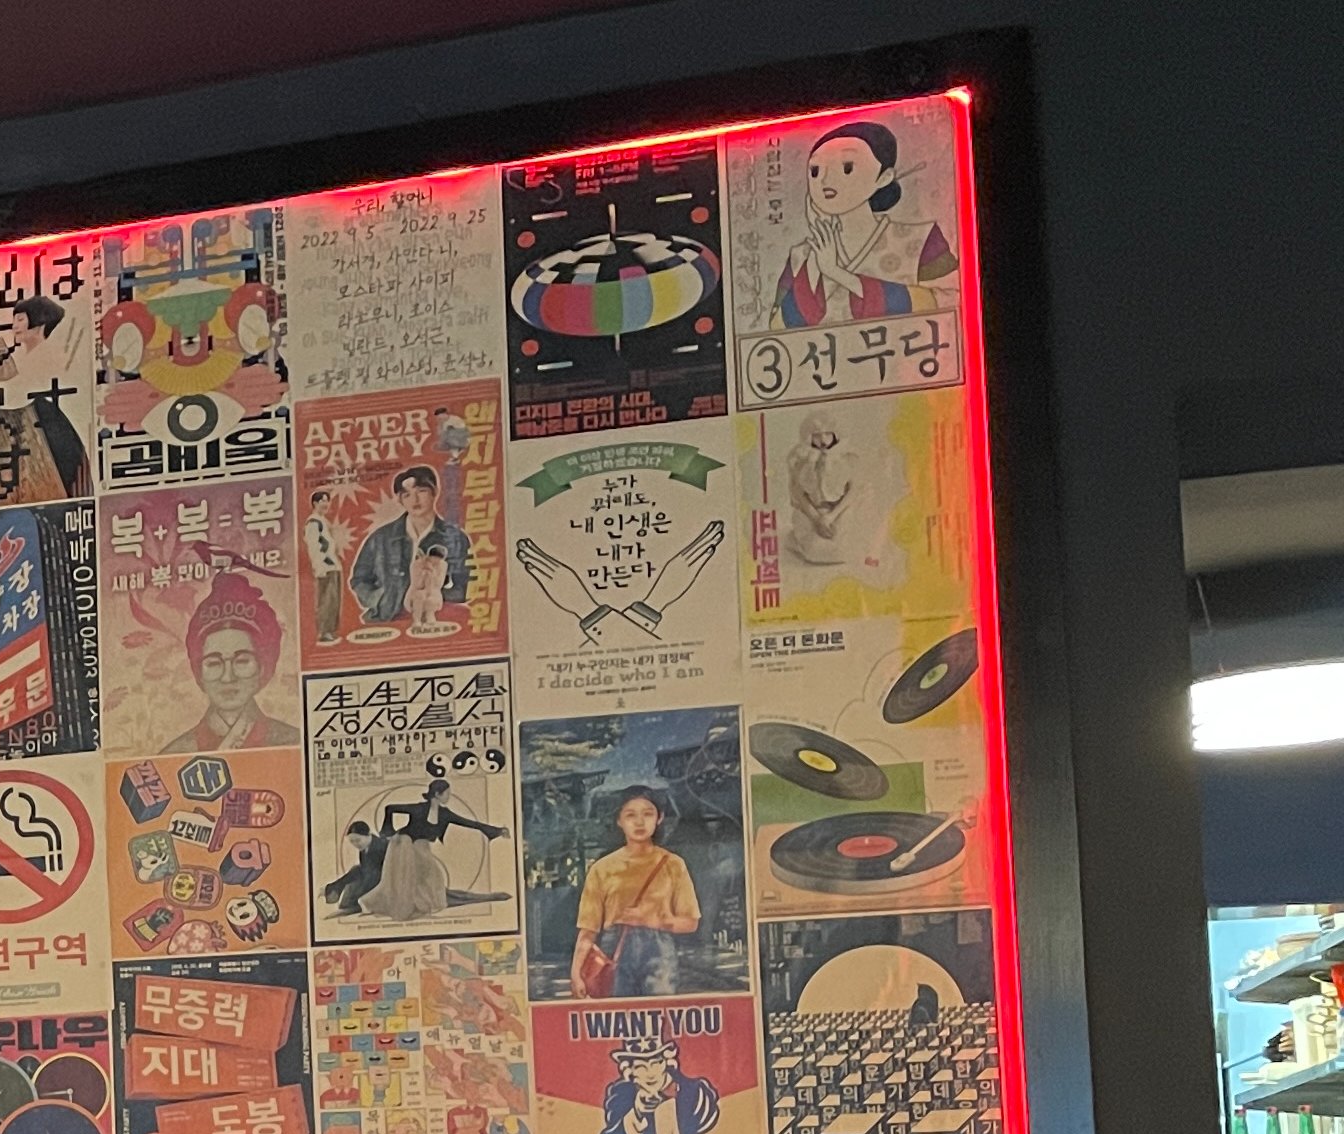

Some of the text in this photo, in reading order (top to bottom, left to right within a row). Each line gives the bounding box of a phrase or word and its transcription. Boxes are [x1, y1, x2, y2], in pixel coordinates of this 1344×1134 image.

[301, 231, 339, 250] 2022
[347, 227, 356, 243] 9
[366, 226, 374, 240] 5
[466, 208, 487, 225] 25
[798, 319, 950, 391] 선무당
[304, 408, 432, 446] AFTER
[304, 432, 432, 470] PARTY
[111, 511, 144, 558] 복
[569, 511, 672, 539] 내 인생은
[596, 542, 646, 562] 내가
[112, 573, 145, 592] 새해
[587, 561, 656, 590] 만든다
[549, 673, 615, 690] decide
[620, 668, 656, 683] who
[676, 666, 705, 679] am
[141, 985, 248, 1037] 무중력
[569, 1005, 723, 1041] I WANT YOU
[141, 1045, 219, 1085] 지대
